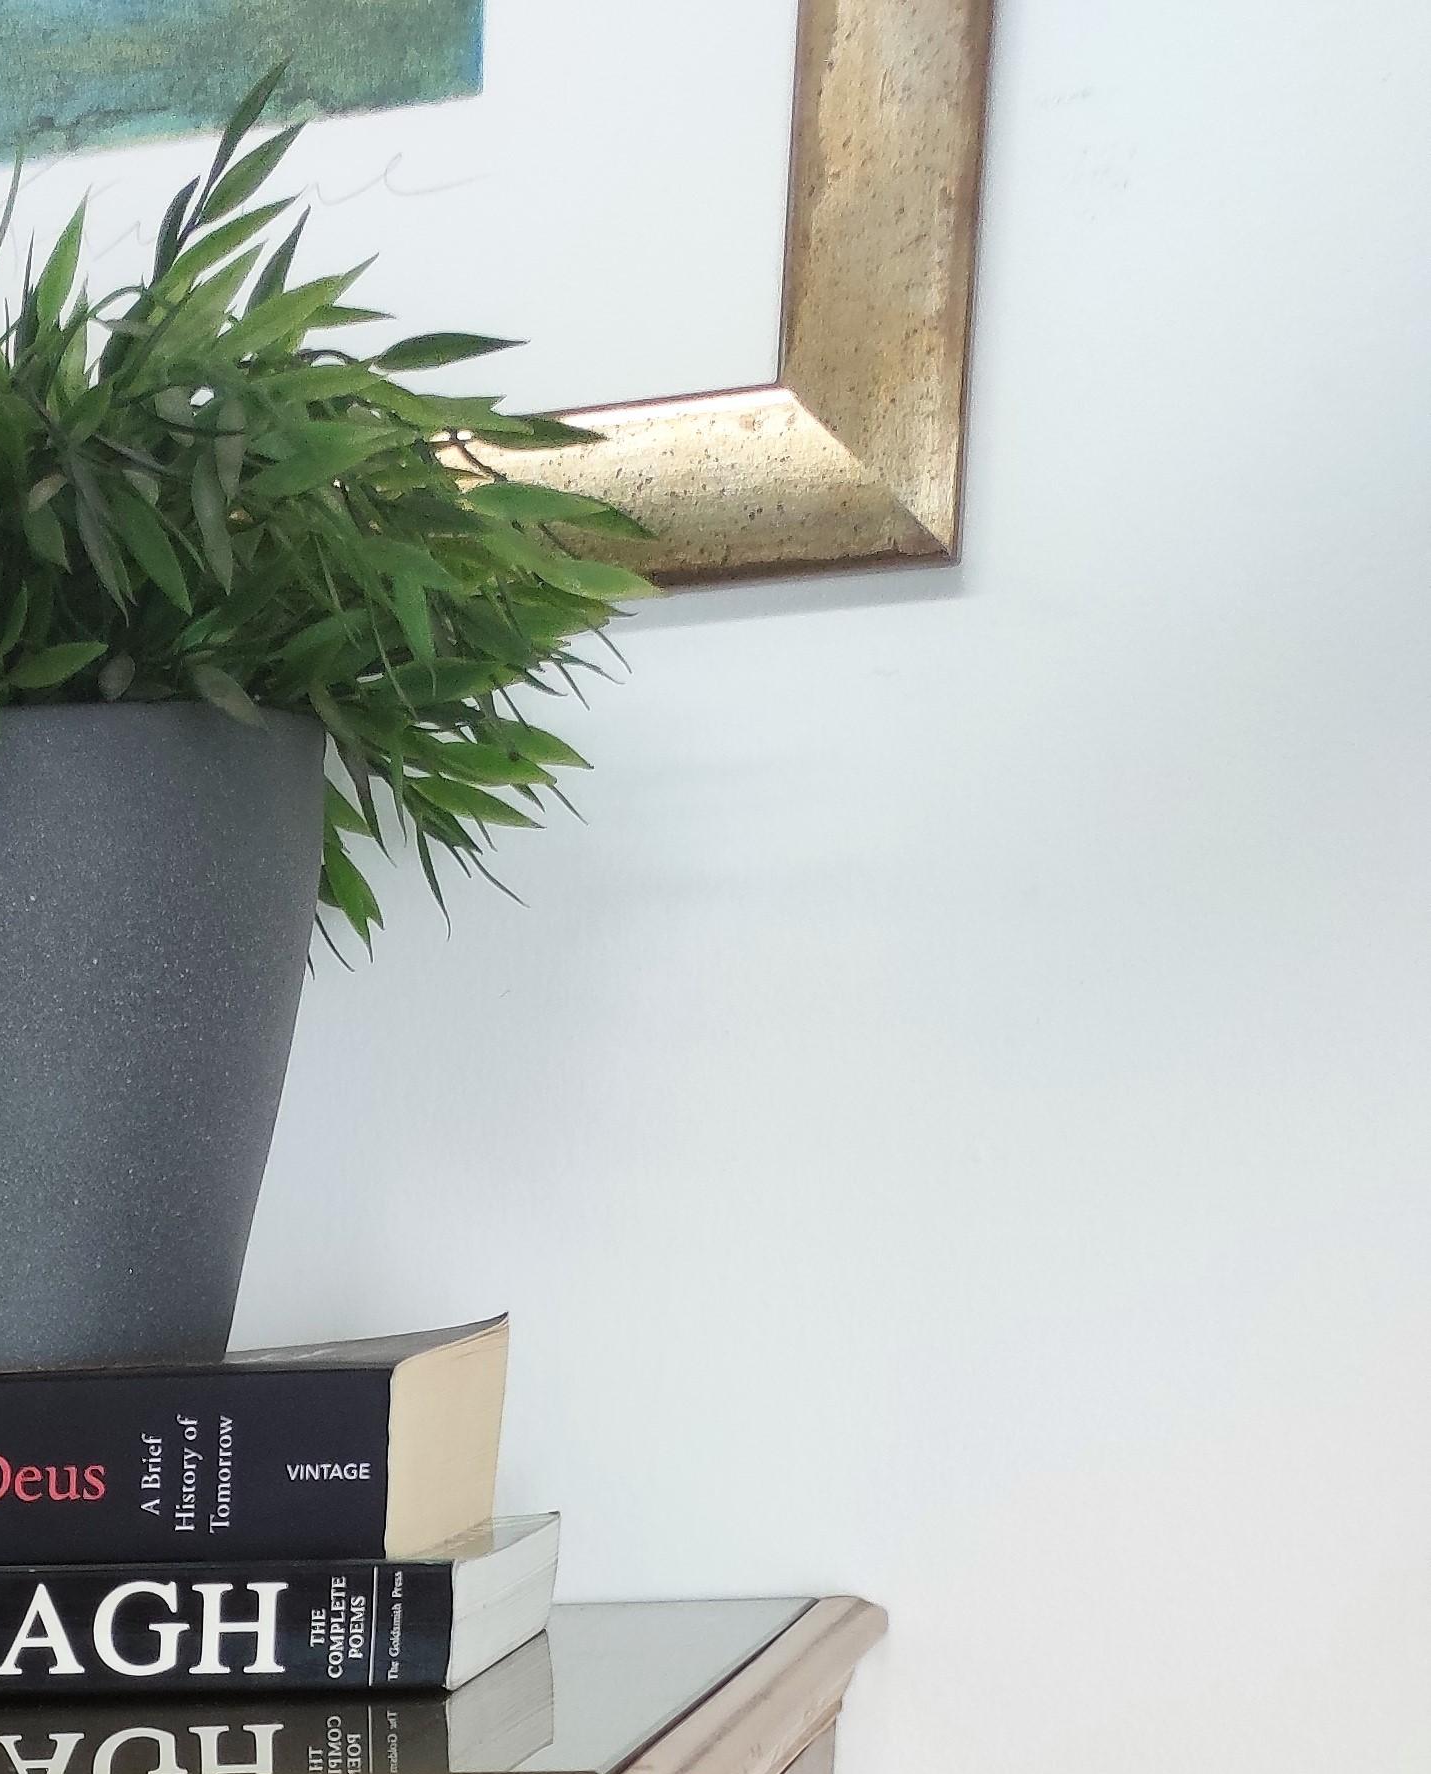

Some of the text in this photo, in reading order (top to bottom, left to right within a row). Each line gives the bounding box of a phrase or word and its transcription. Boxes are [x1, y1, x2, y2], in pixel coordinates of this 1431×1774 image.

[140, 1433, 163, 1516] A Brief
[174, 1414, 204, 1532] History of
[209, 1415, 233, 1534] Tomorrow
[286, 1462, 372, 1480] VINTAGE
[310, 1608, 326, 1648] THE
[328, 1576, 347, 1679] COMPLETE
[347, 1595, 366, 1659] POEMS
[387, 1571, 404, 1682] The Goldsmith Press
